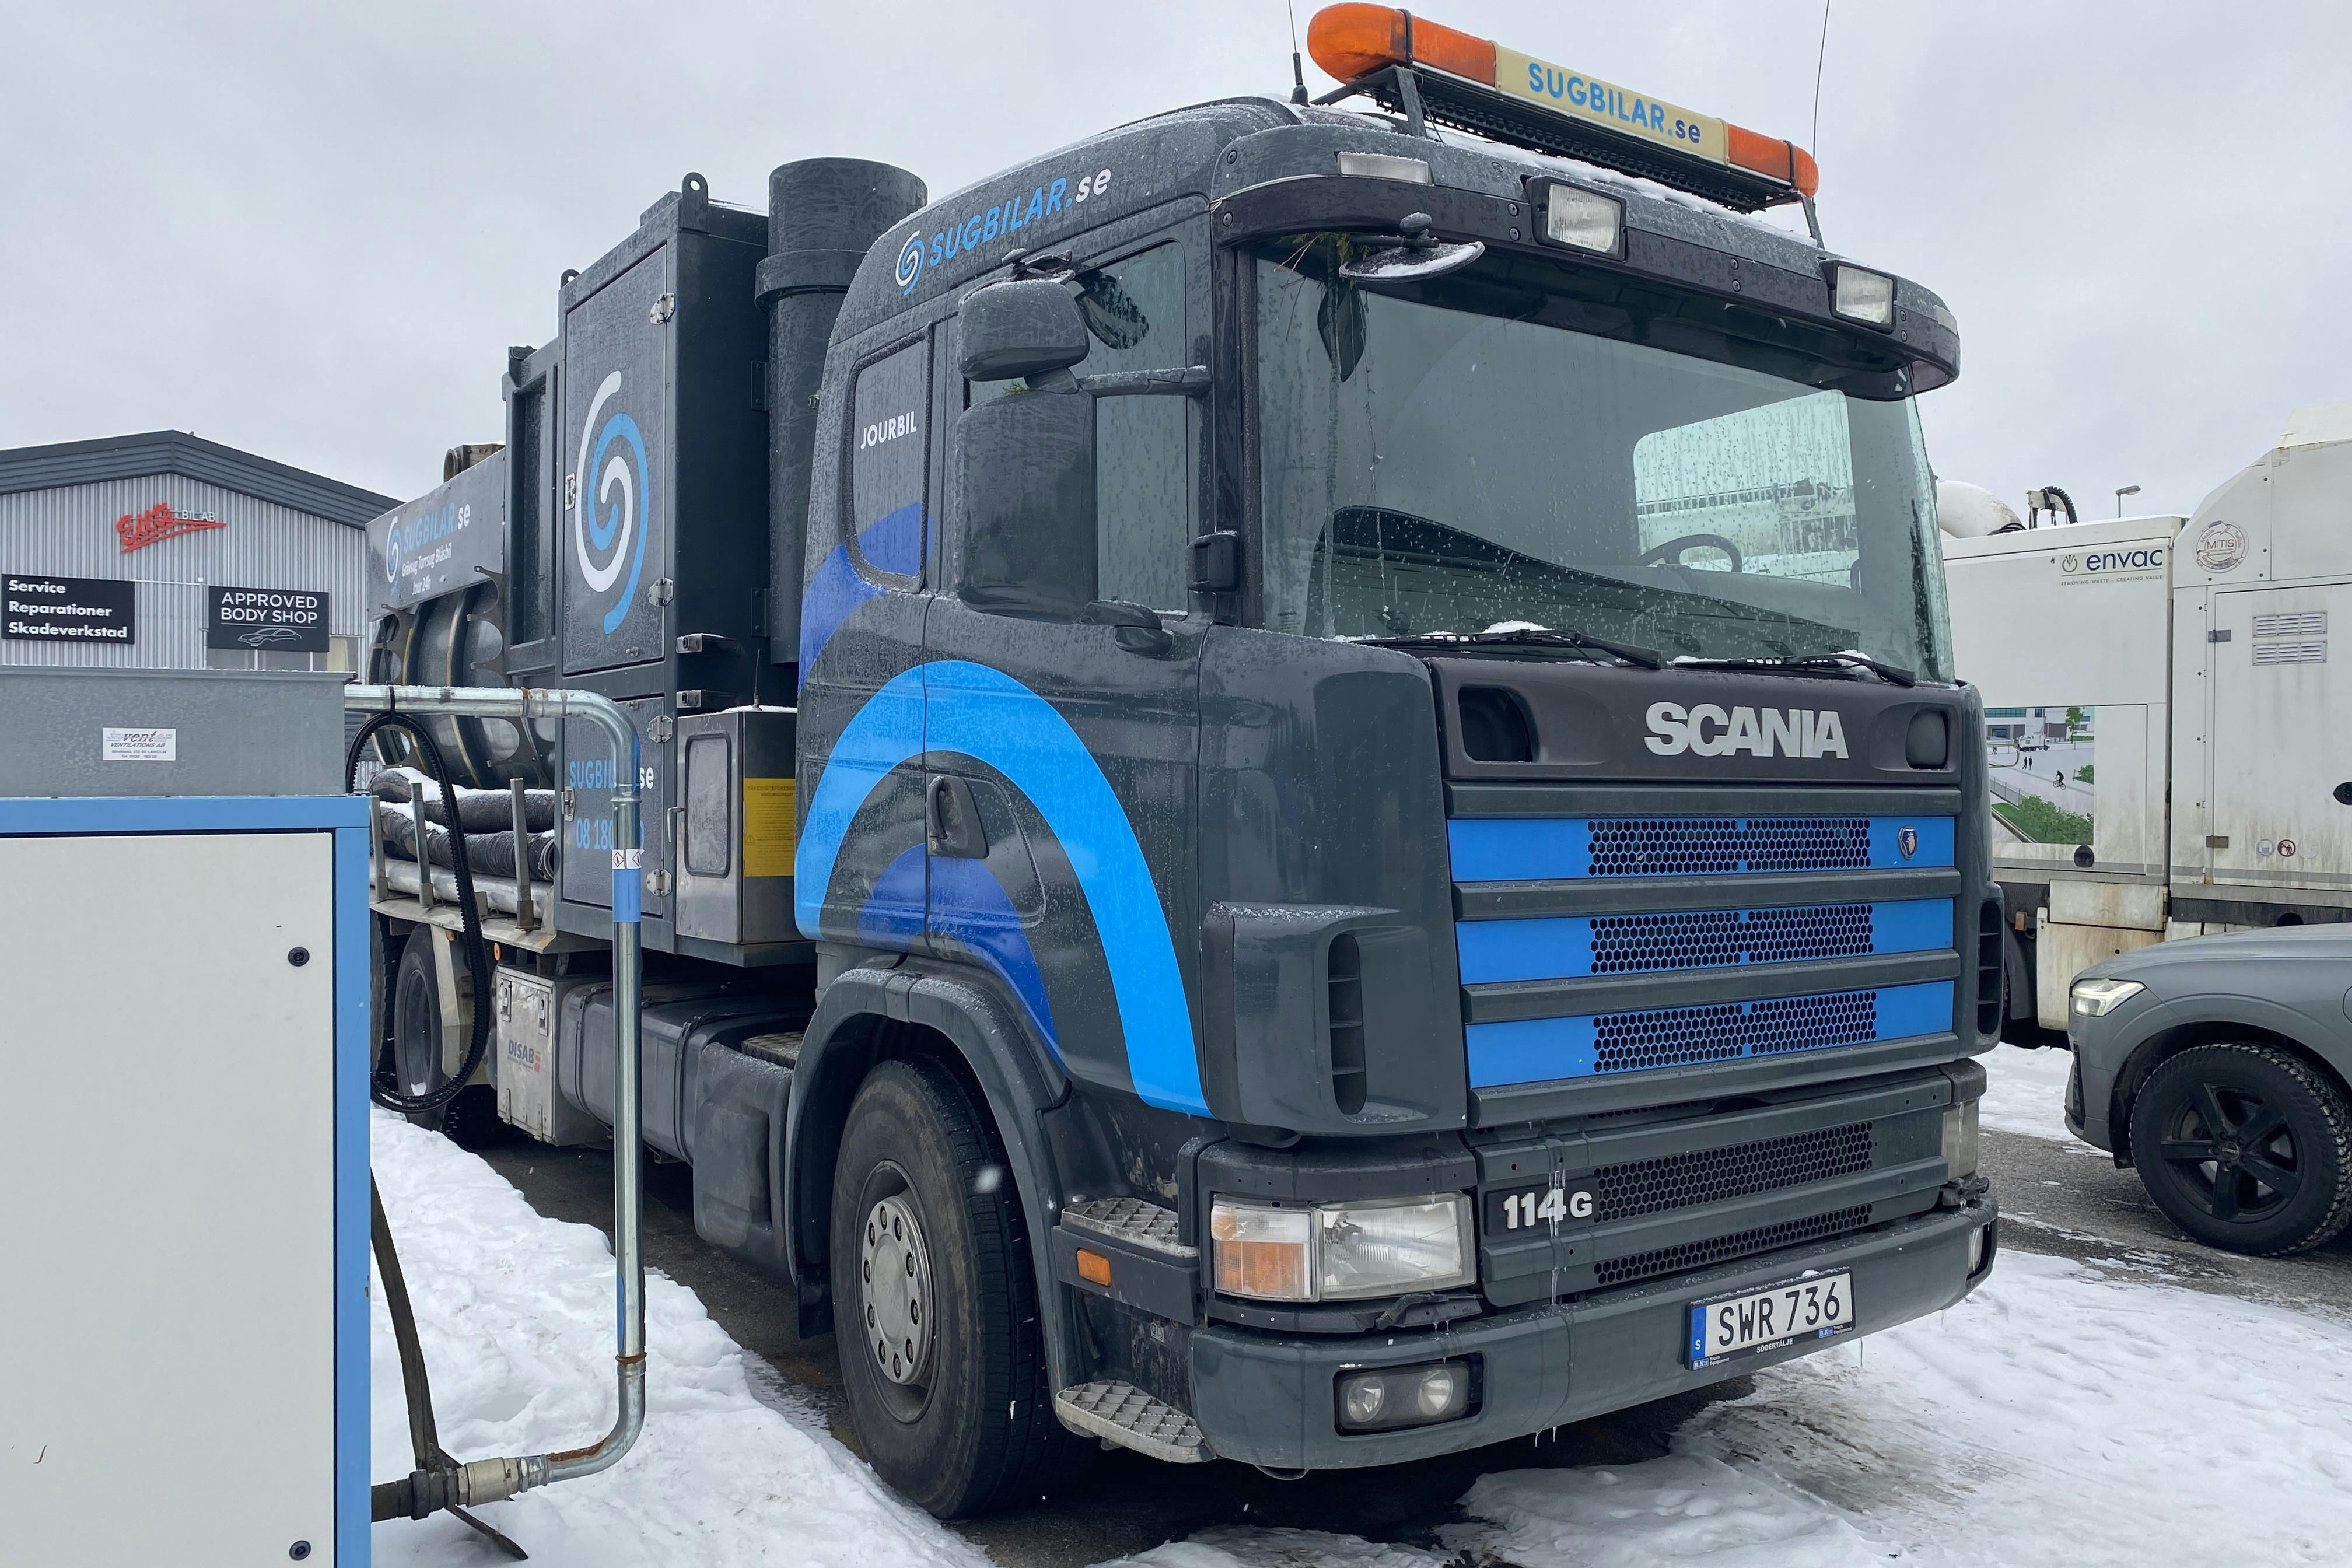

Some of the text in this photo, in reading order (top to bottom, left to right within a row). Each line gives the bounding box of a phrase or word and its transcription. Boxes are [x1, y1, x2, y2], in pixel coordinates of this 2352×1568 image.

[1528, 63, 1701, 144] SUGBILAR.se
[930, 169, 1111, 267] SUGBILAR.se
[860, 411, 917, 450] JOURBIL
[182, 509, 199, 520] BIL
[201, 512, 215, 522] AB
[404, 503, 470, 554] SUGBILAR.se
[2086, 549, 2163, 571] envac
[9, 579, 66, 594] Service
[9, 600, 113, 617] Reparationer
[221, 592, 318, 609] APPROVED
[220, 607, 318, 624] BODY SHOP
[9, 621, 128, 638] Skadeverkstad
[1644, 701, 1849, 759] SCANIA
[569, 760, 654, 789] SUGBILse
[576, 818, 590, 849] 08
[509, 1040, 534, 1064] DISAB
[1695, 1282, 1840, 1351] S SWR 736
[1756, 1338, 1793, 1353] SÖDERTÄLJE
